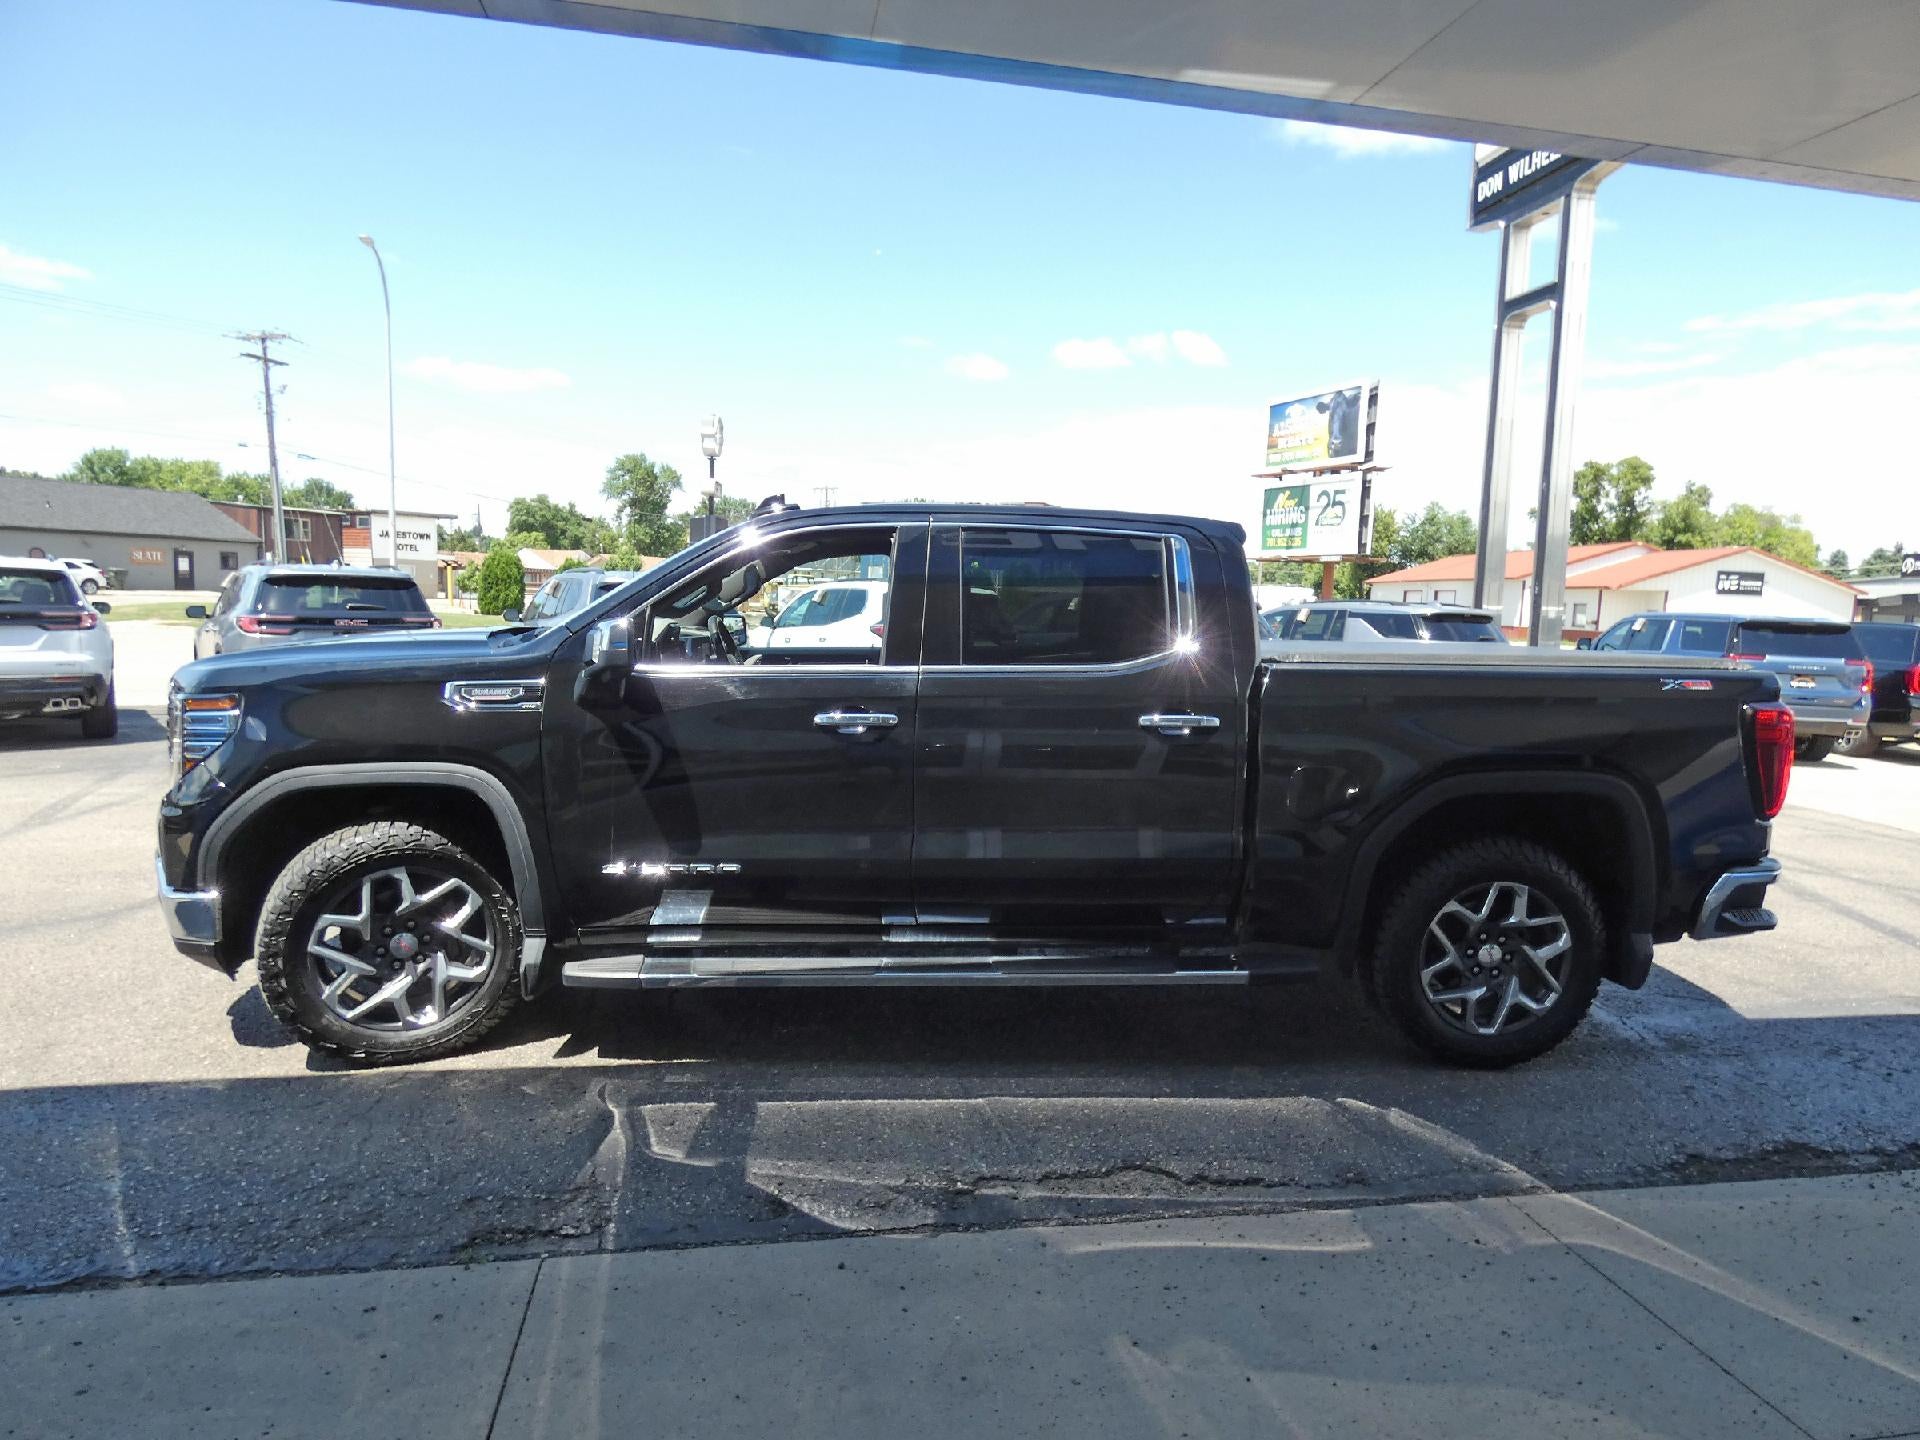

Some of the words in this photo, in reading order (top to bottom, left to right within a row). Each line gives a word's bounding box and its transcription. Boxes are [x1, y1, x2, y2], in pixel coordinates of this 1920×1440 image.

[1477, 170, 1504, 203] DON
[1265, 505, 1307, 527] HIRING
[1315, 489, 1347, 527] 25
[379, 530, 432, 541] JAESTOWN
[393, 543, 420, 552] OTEL
